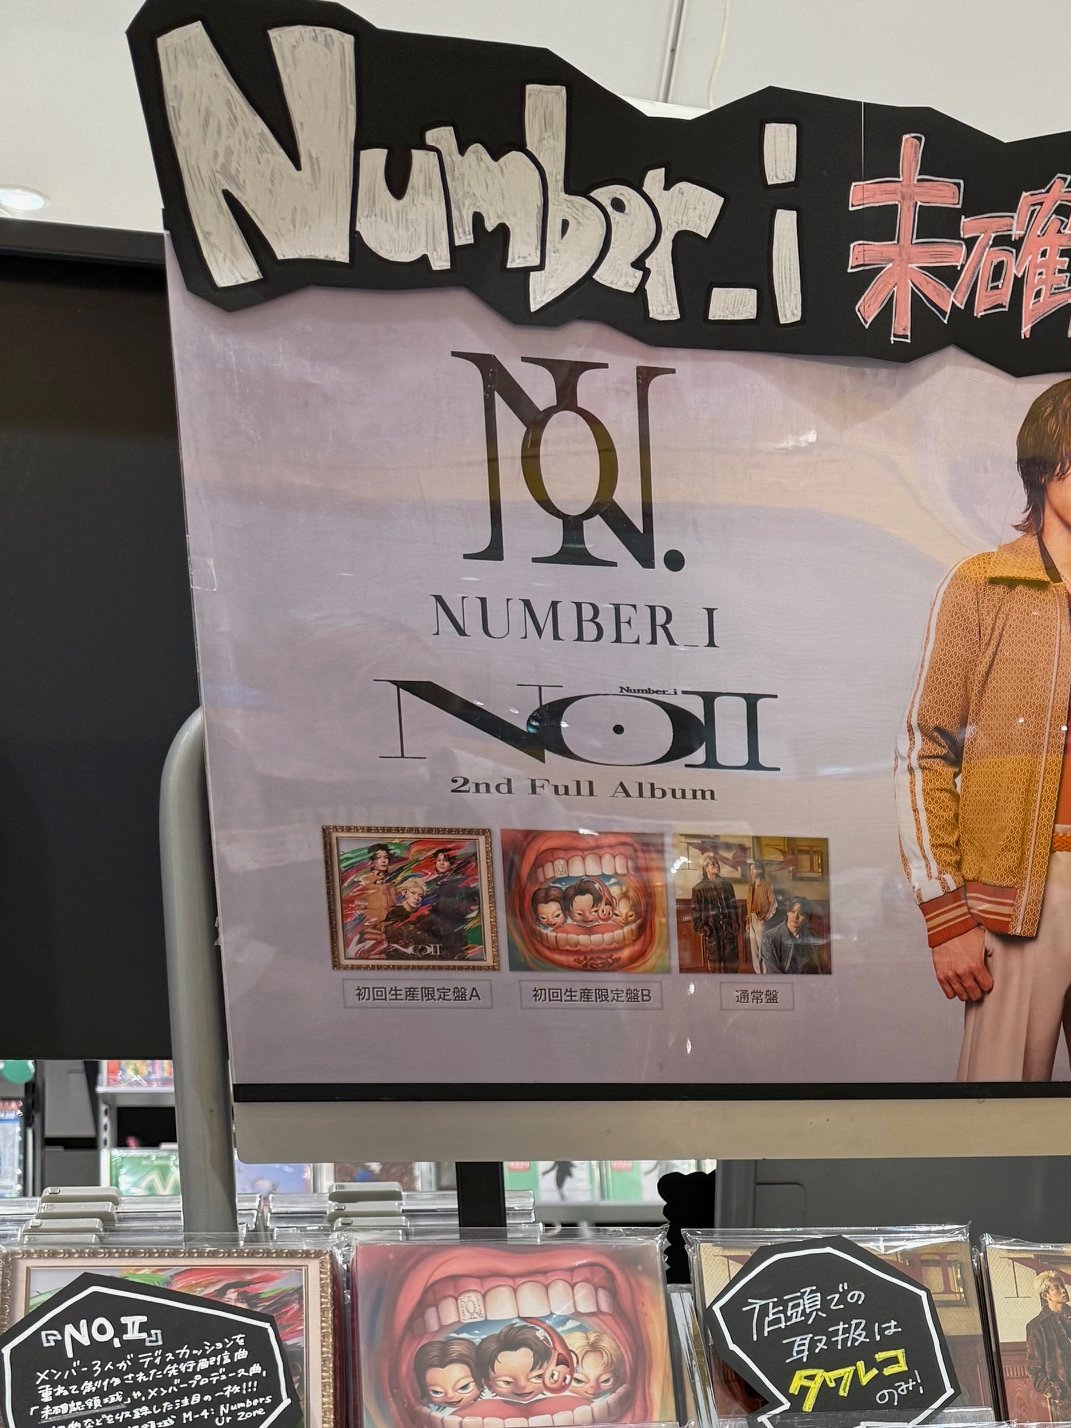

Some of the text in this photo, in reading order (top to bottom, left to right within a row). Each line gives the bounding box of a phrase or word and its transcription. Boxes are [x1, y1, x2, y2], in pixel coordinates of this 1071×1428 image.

[156, 20, 803, 325] Number_i
[450, 776, 717, 801] 2nd Full Album
[355, 985, 481, 1003] 初回生産限定盤A
[532, 987, 652, 1004] 初回生産限定盤B
[735, 989, 780, 1005] 通常盤
[742, 1282, 866, 1341] 店頭での
[782, 1319, 902, 1363] 取扱は
[788, 1348, 909, 1413] タワレコ
